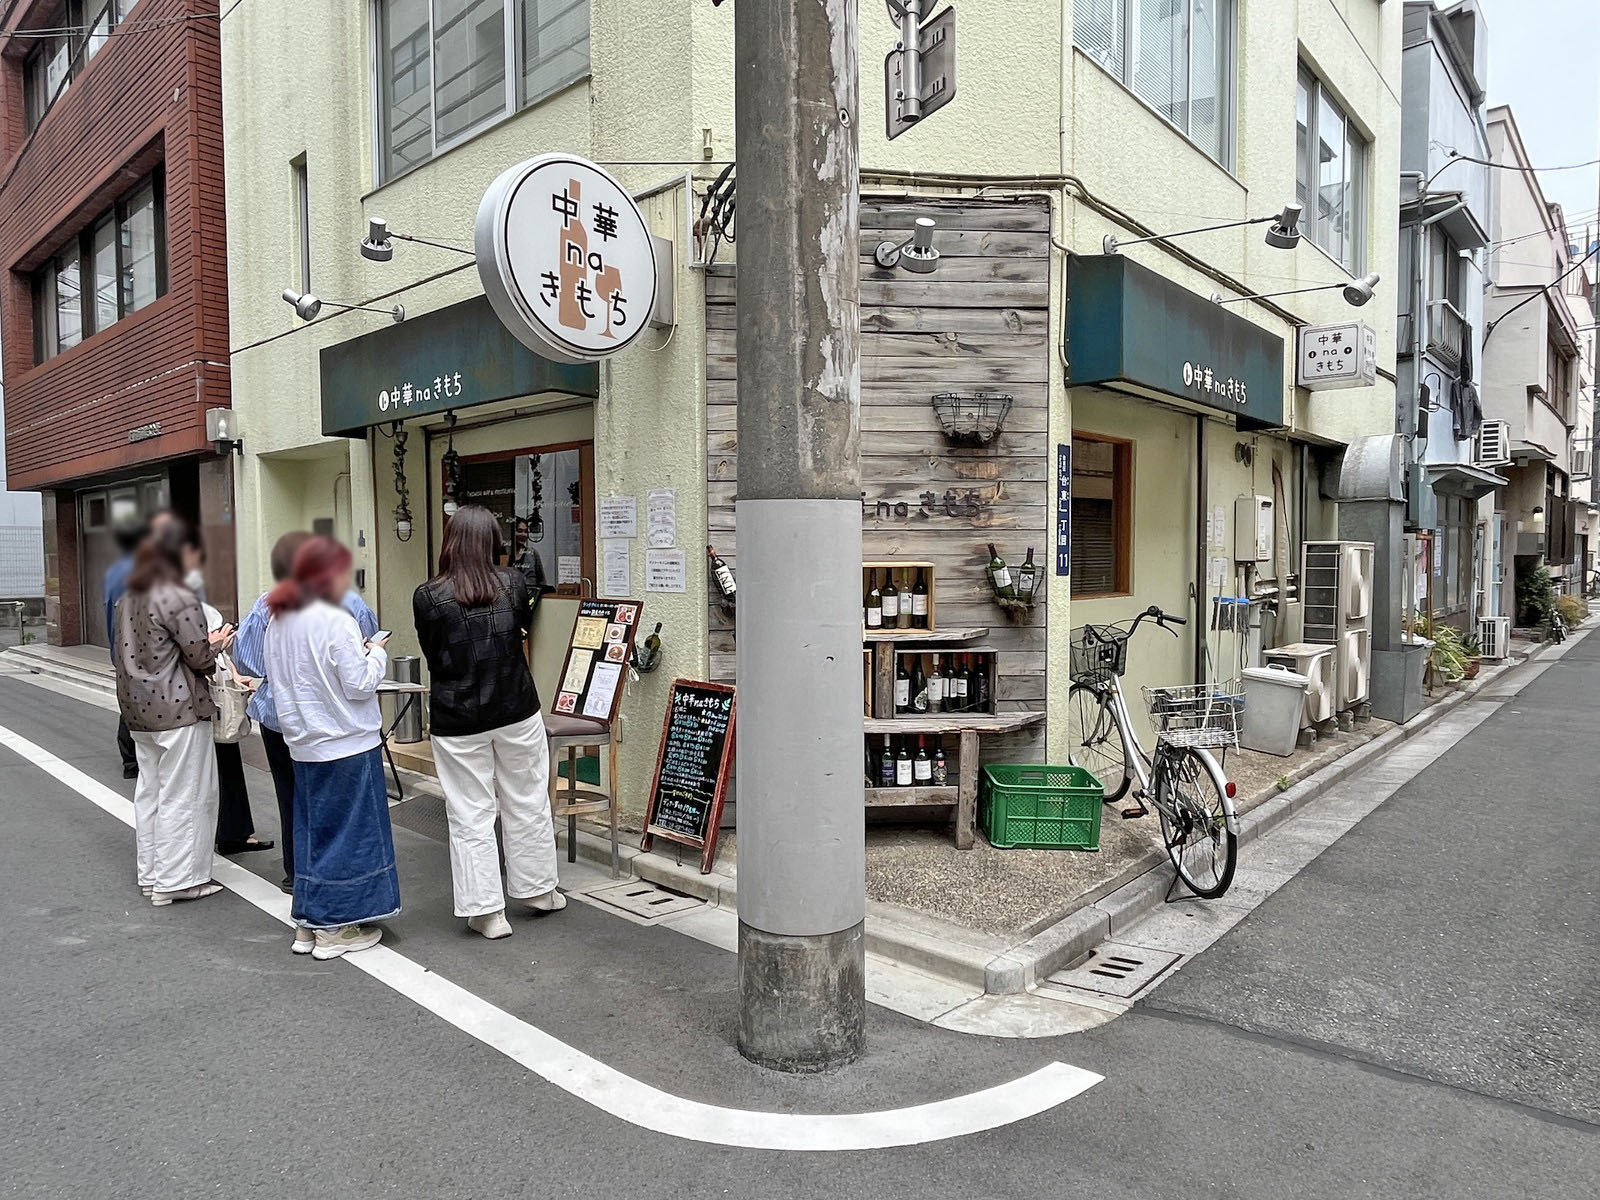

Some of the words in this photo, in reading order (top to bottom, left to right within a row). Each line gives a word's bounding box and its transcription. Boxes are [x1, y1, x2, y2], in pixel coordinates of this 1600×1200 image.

[552, 188, 619, 242] 中華
[567, 242, 603, 273] na
[540, 271, 628, 326] きもち
[1318, 332, 1343, 346] 中華
[1316, 359, 1344, 372] きもち
[390, 371, 462, 408] 中華naきもち
[1193, 363, 1247, 404] 中華naきもち
[1060, 553, 1068, 568] 11
